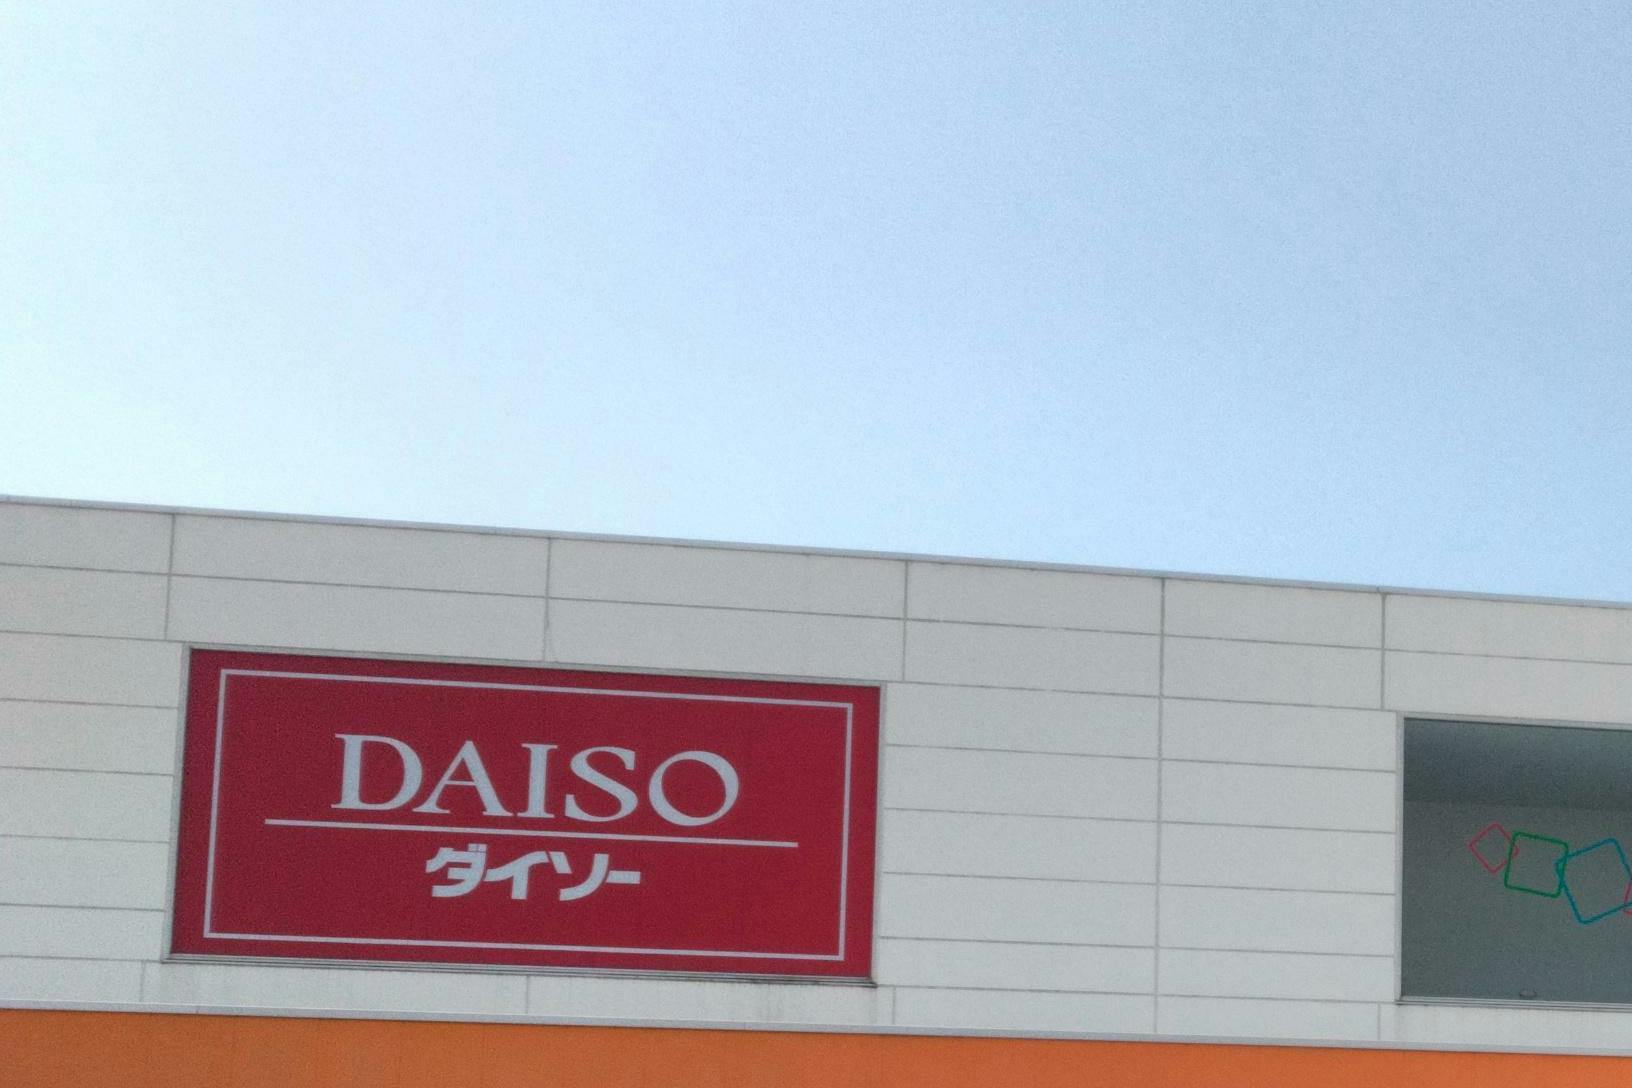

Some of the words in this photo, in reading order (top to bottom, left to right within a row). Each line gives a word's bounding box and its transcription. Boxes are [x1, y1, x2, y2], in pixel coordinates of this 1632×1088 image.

[331, 734, 740, 827] DAISO
[425, 843, 642, 902] ダイソー
